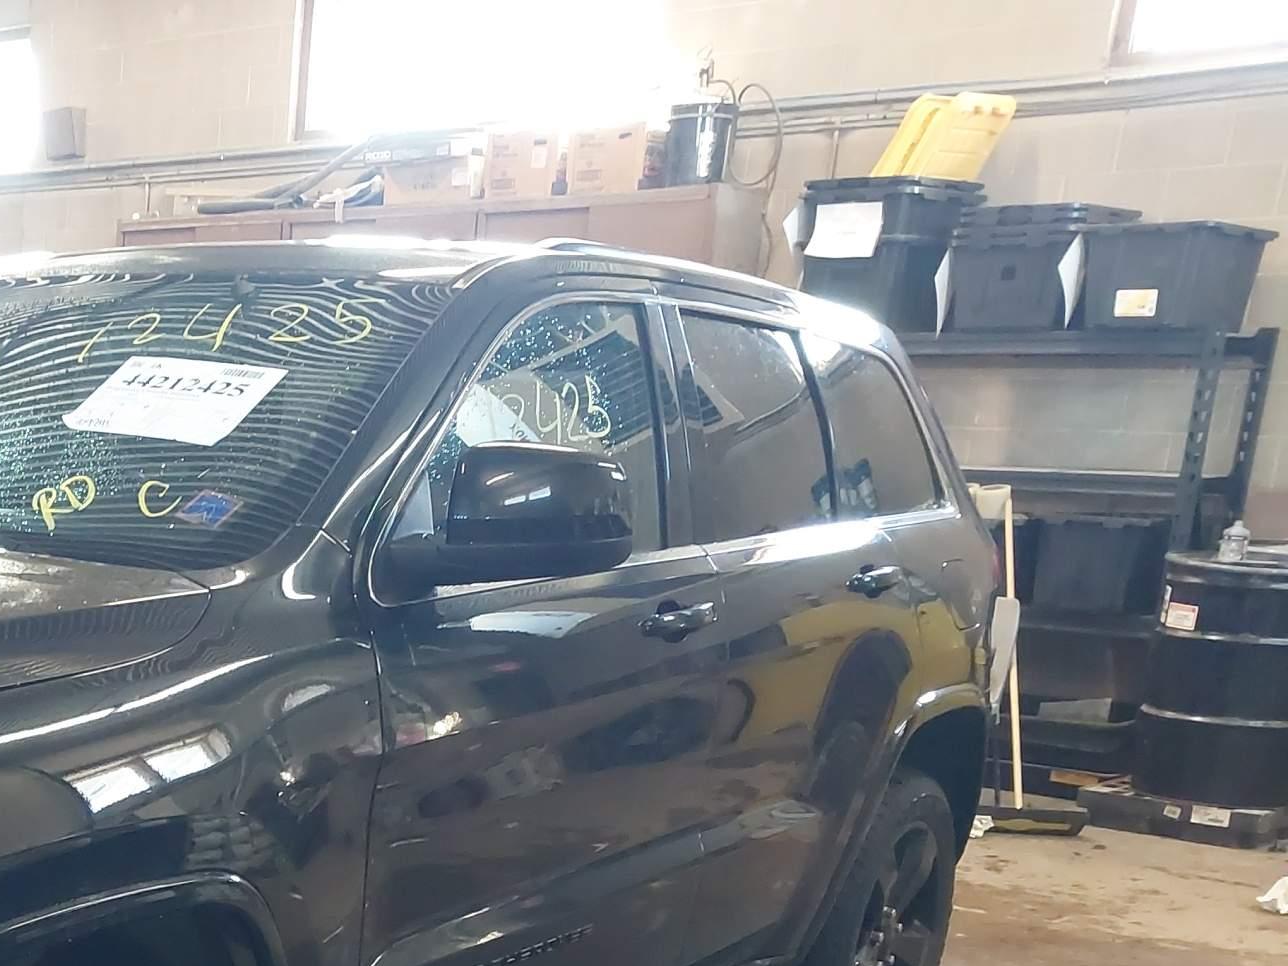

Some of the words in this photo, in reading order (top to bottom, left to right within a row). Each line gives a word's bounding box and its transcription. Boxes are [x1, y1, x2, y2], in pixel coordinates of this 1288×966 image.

[78, 299, 386, 363] 12425
[122, 373, 251, 397] 44212425
[31, 475, 96, 532] RD
